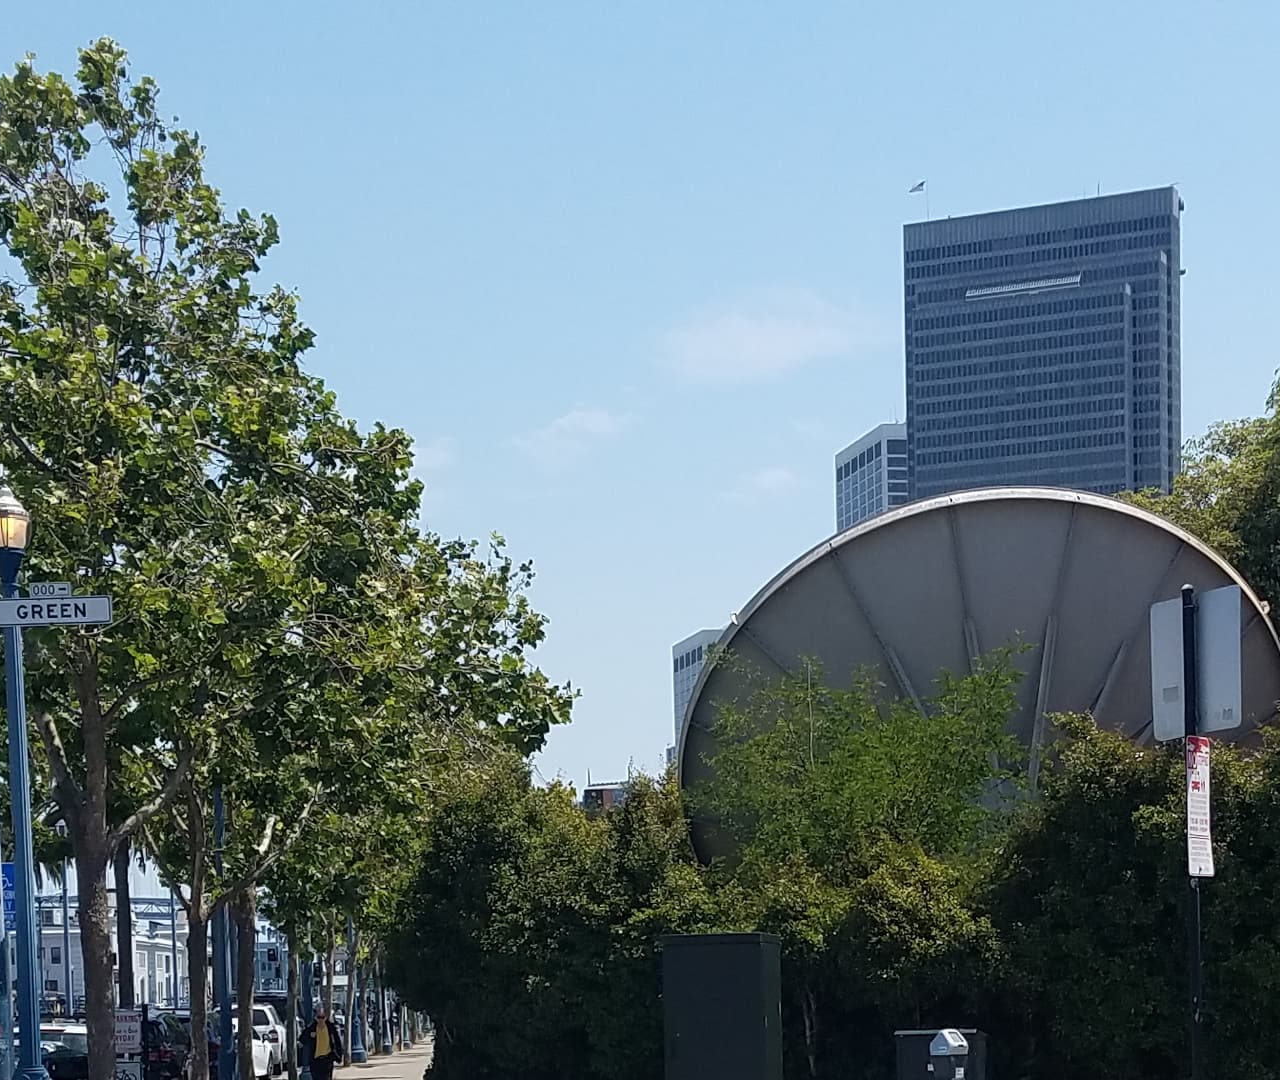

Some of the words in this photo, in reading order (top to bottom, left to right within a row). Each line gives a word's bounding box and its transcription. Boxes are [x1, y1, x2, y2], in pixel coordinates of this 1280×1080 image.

[32, 584, 55, 596] 000
[16, 603, 87, 619] GREEN
[113, 1015, 139, 1023] ARKING
